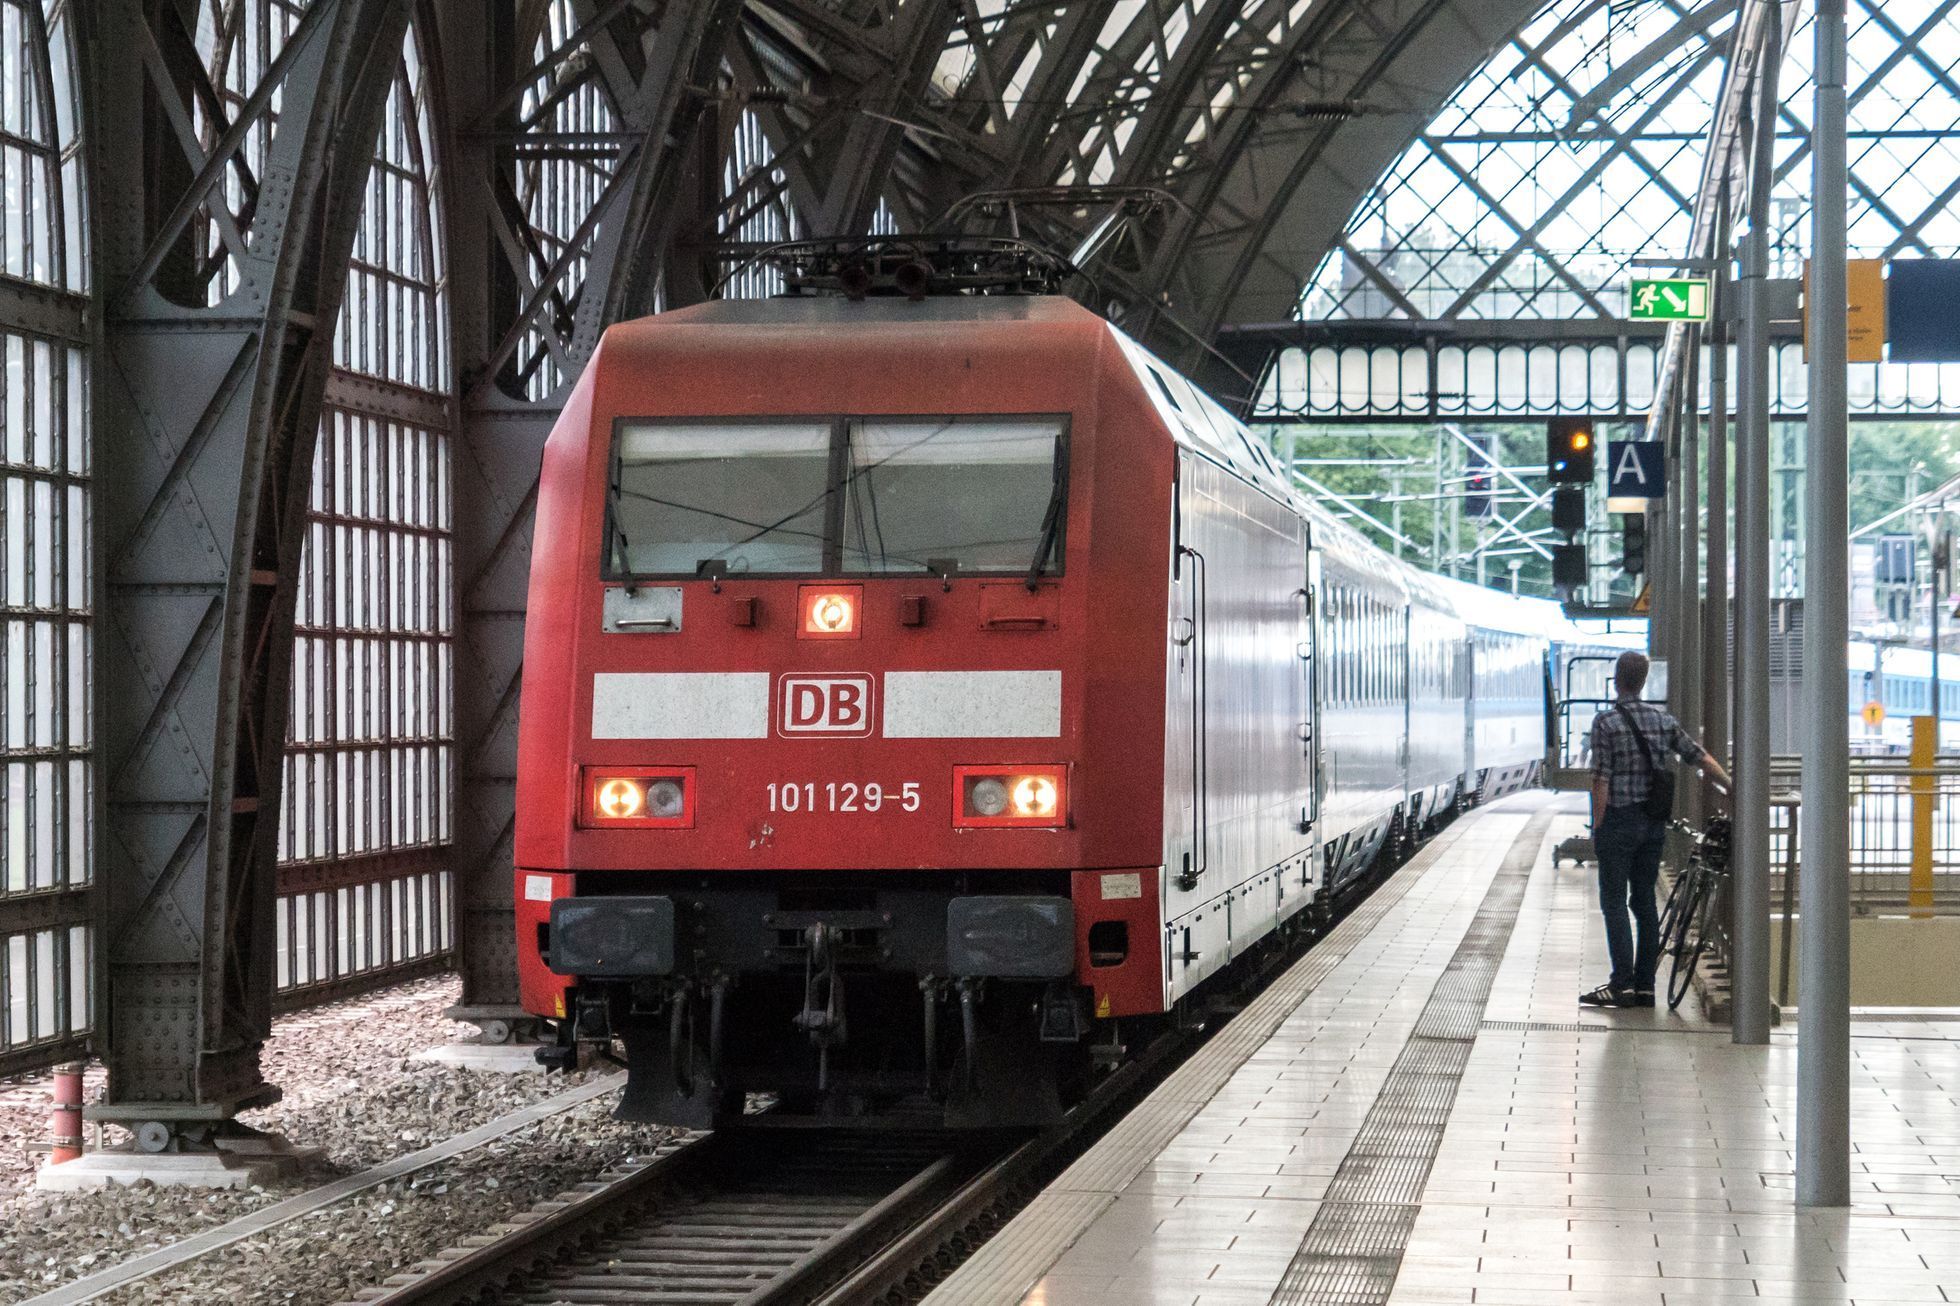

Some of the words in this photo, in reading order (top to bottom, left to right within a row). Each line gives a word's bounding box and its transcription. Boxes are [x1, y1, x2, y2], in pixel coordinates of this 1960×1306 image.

[1613, 444, 1646, 484] A
[791, 684, 861, 726] DB
[766, 783, 815, 812] 101
[825, 783, 920, 812] 129-5
